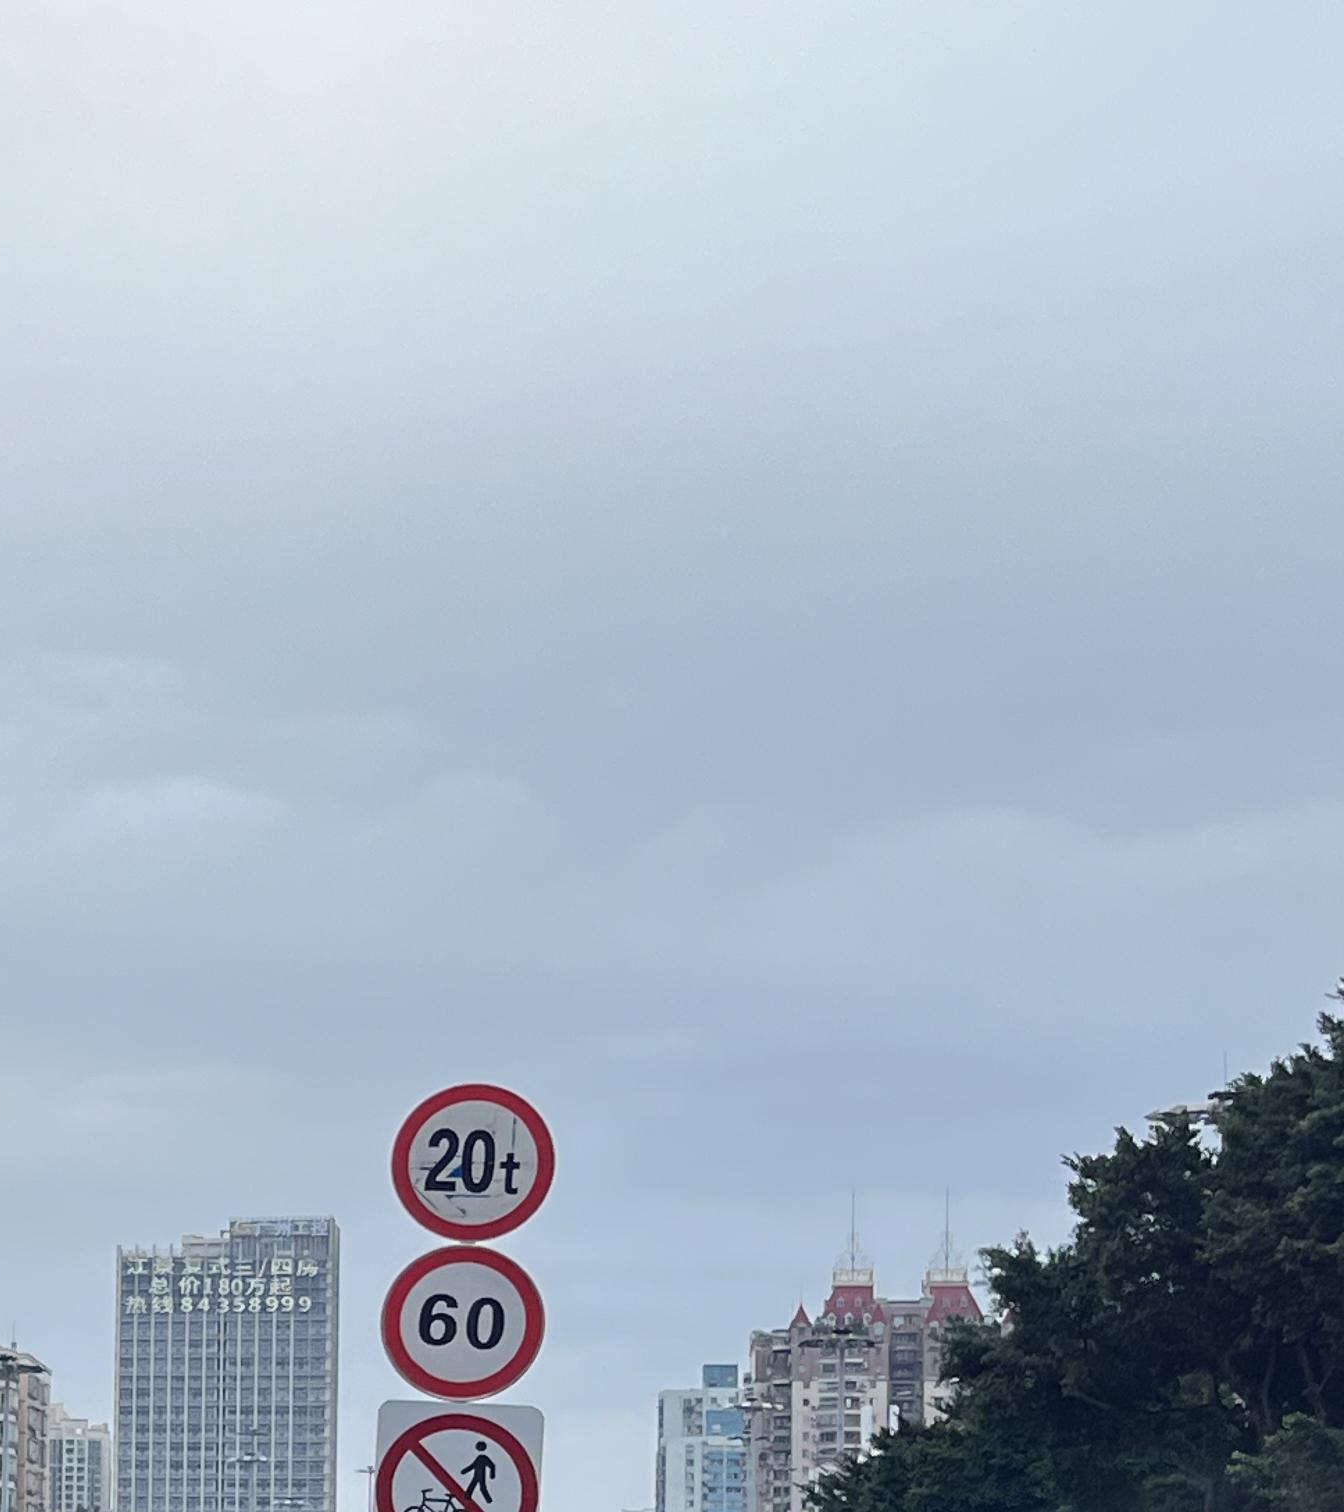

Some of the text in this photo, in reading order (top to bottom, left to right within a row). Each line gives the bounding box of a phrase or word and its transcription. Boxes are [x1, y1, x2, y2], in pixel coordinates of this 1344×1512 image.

[424, 1128, 520, 1195] 20t
[149, 1277, 292, 1296] 总价180万起
[419, 1293, 505, 1350] 60
